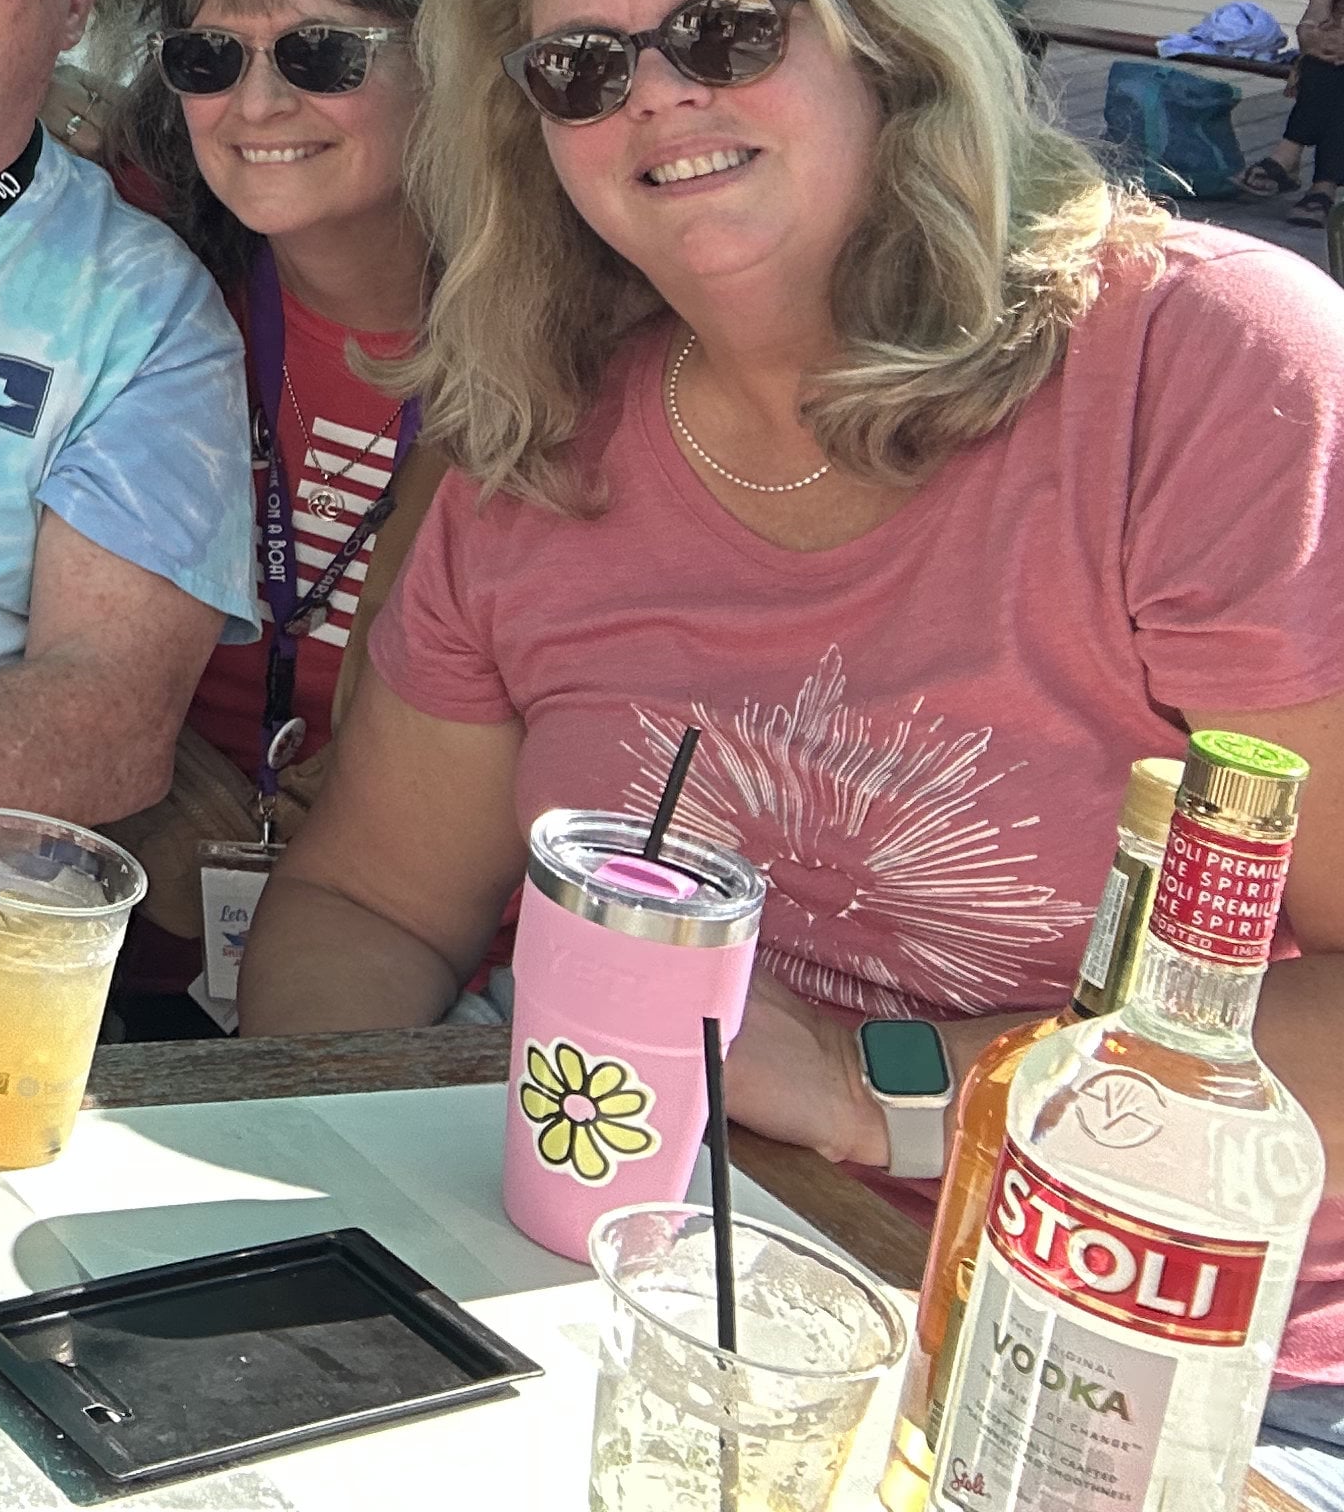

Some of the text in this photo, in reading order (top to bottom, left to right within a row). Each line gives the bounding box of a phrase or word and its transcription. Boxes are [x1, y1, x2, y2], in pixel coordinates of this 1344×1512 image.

[267, 493, 281, 519] ON
[267, 524, 283, 535] A
[267, 539, 288, 583] BOAT
[1206, 851, 1290, 881] PREMIU
[1197, 890, 1281, 919] PREMIU
[997, 1167, 1220, 1321] STOLI
[991, 1319, 1132, 1423] VODKA
